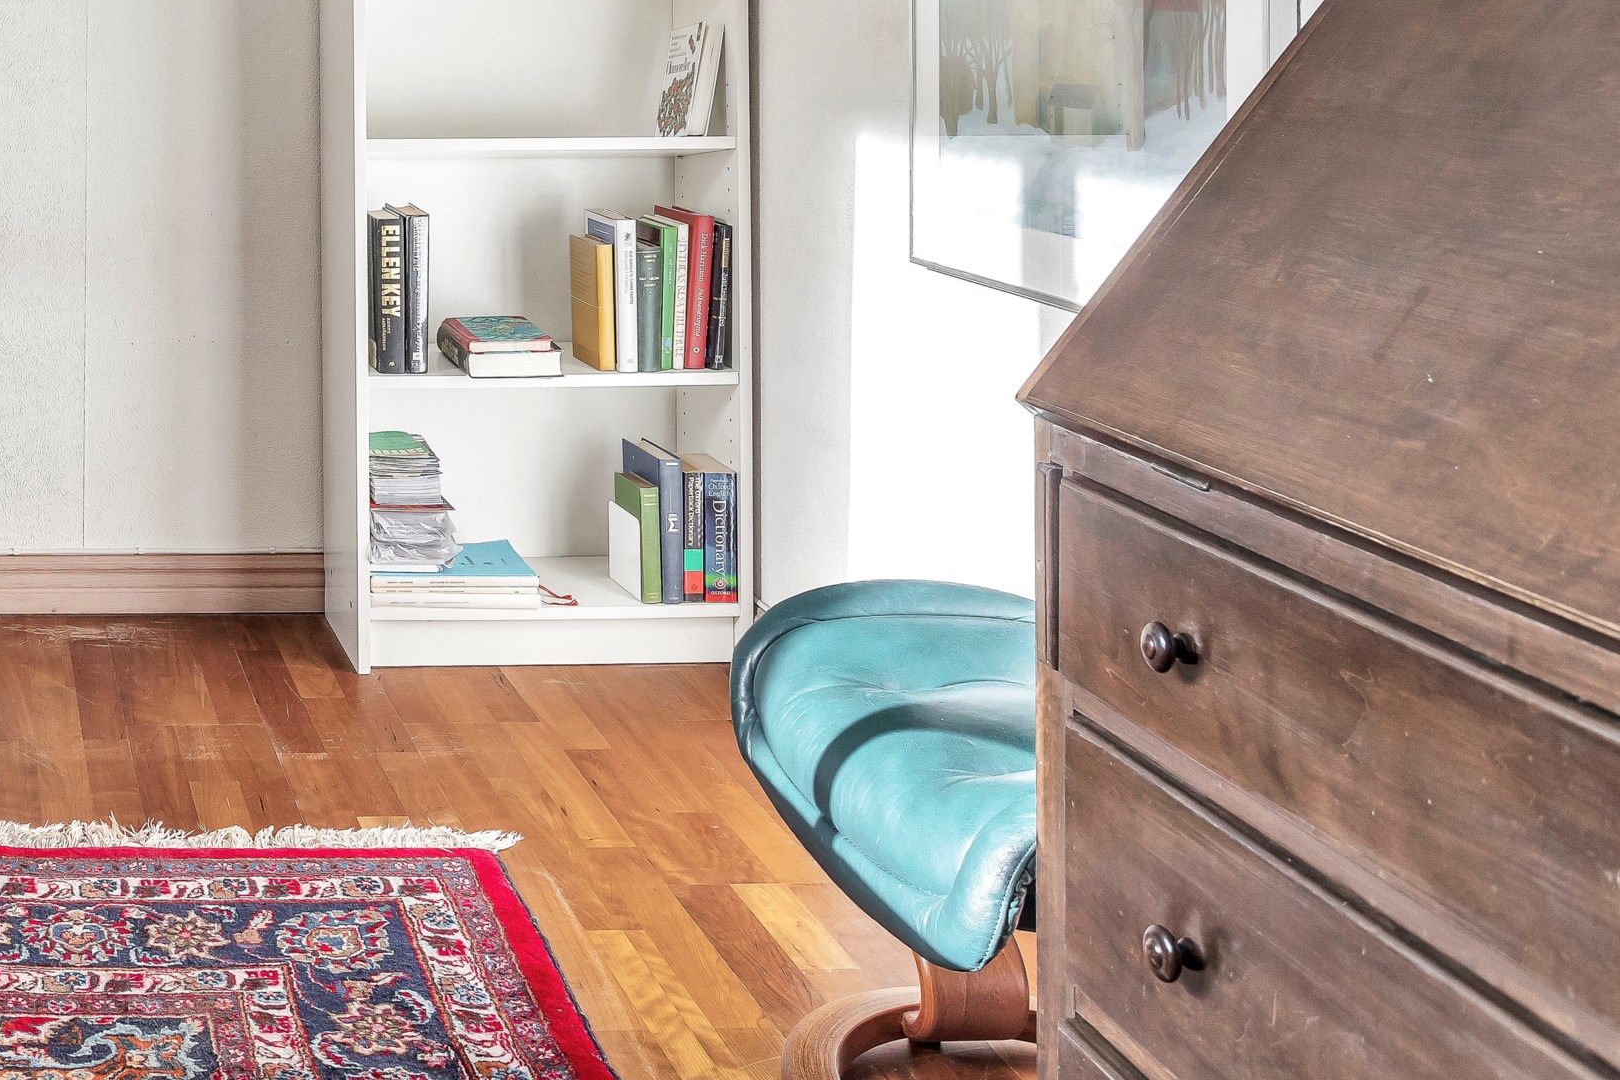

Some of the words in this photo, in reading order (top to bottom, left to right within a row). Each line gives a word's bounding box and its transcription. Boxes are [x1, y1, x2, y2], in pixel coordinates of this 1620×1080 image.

[381, 225, 401, 280] ELLEN
[698, 251, 707, 282] Harrison
[381, 283, 401, 318] KEY
[677, 285, 686, 307] RESA
[676, 310, 685, 328] TILL
[675, 330, 684, 358] THULE
[687, 512, 695, 547] Dictionary
[711, 499, 727, 575] Dictionary
